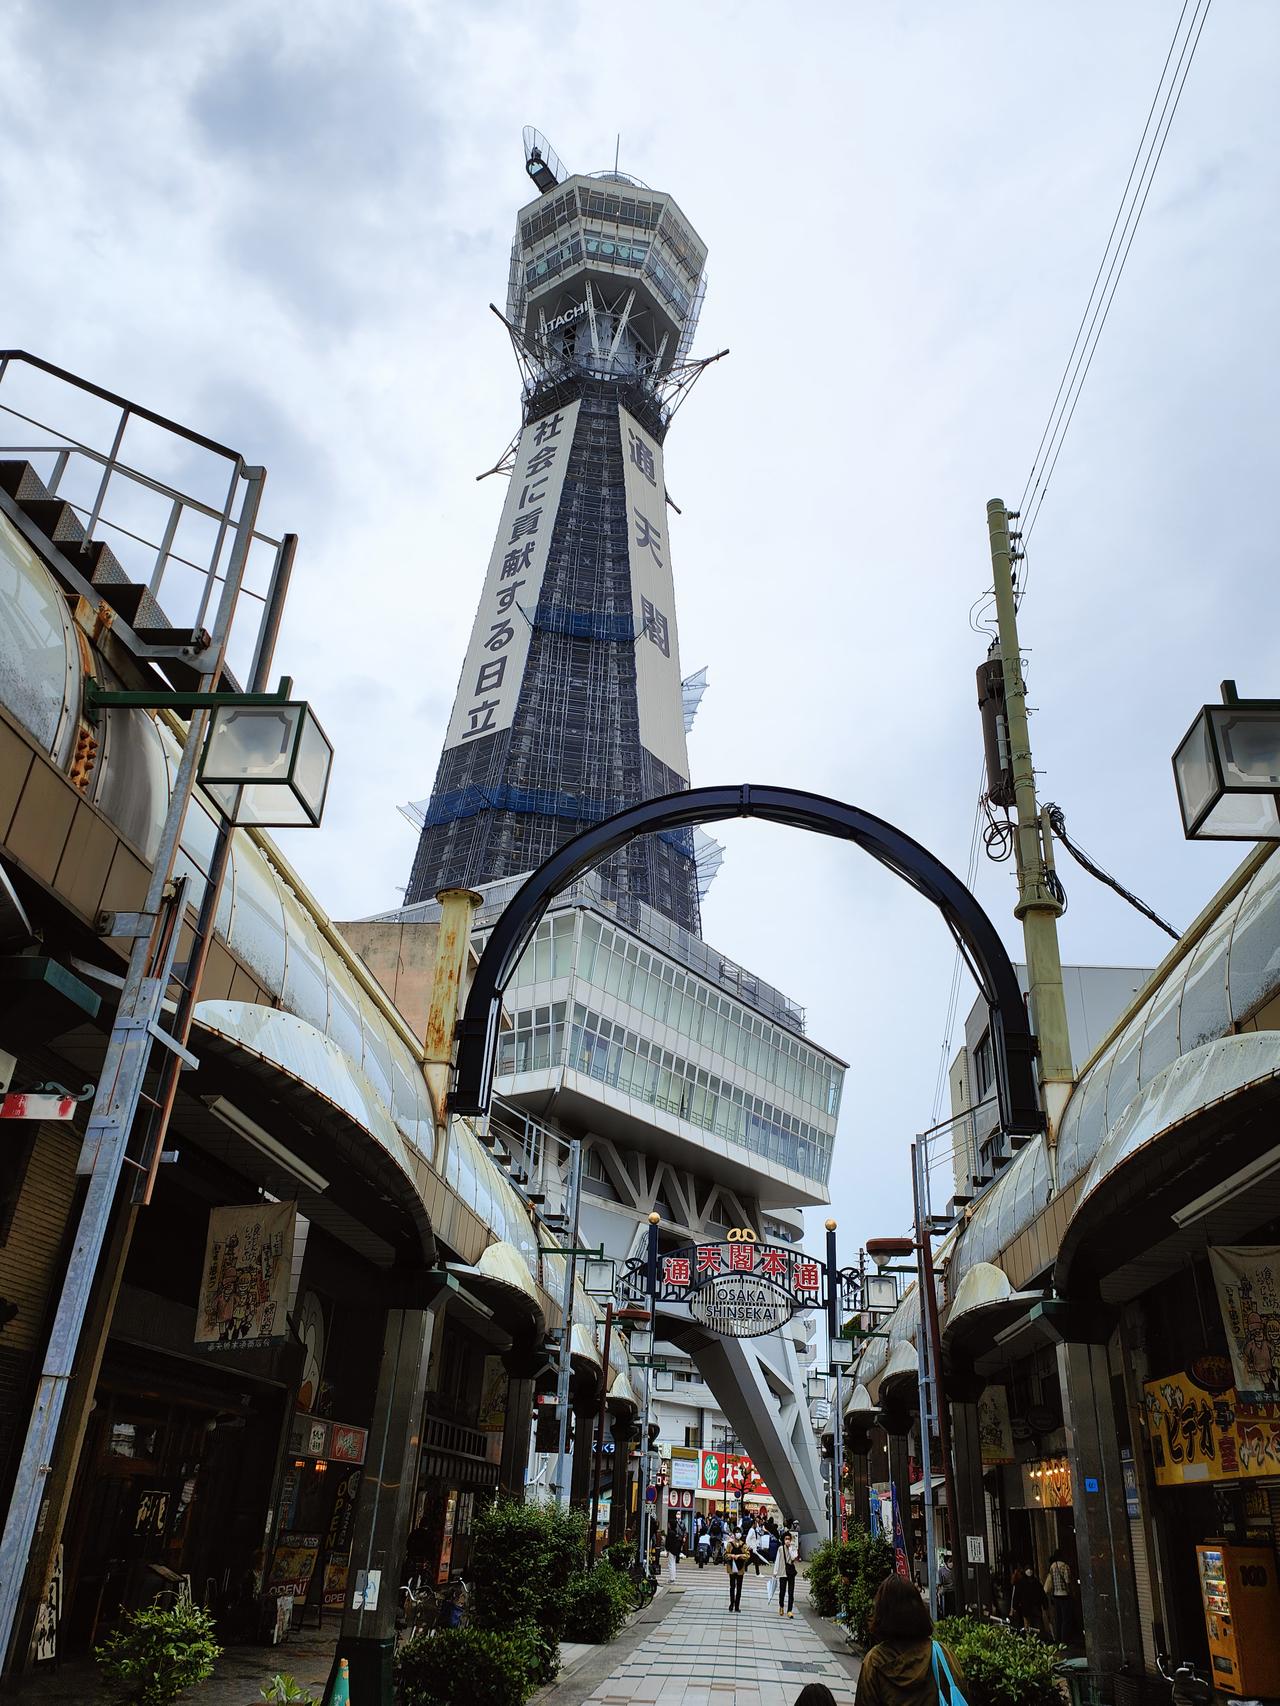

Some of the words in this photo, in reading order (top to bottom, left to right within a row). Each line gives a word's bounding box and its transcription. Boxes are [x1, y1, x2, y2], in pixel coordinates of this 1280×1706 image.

[627, 426, 671, 659] 通天閣
[461, 412, 566, 740] 社会に貢献する日立
[663, 1243, 820, 1292] 通天閣本通
[705, 1305, 777, 1321] SHINSEKAI
[717, 1288, 767, 1303] OSAKA
[1165, 1397, 1215, 1464] ビデオ
[268, 1581, 308, 1598] OPEN!
